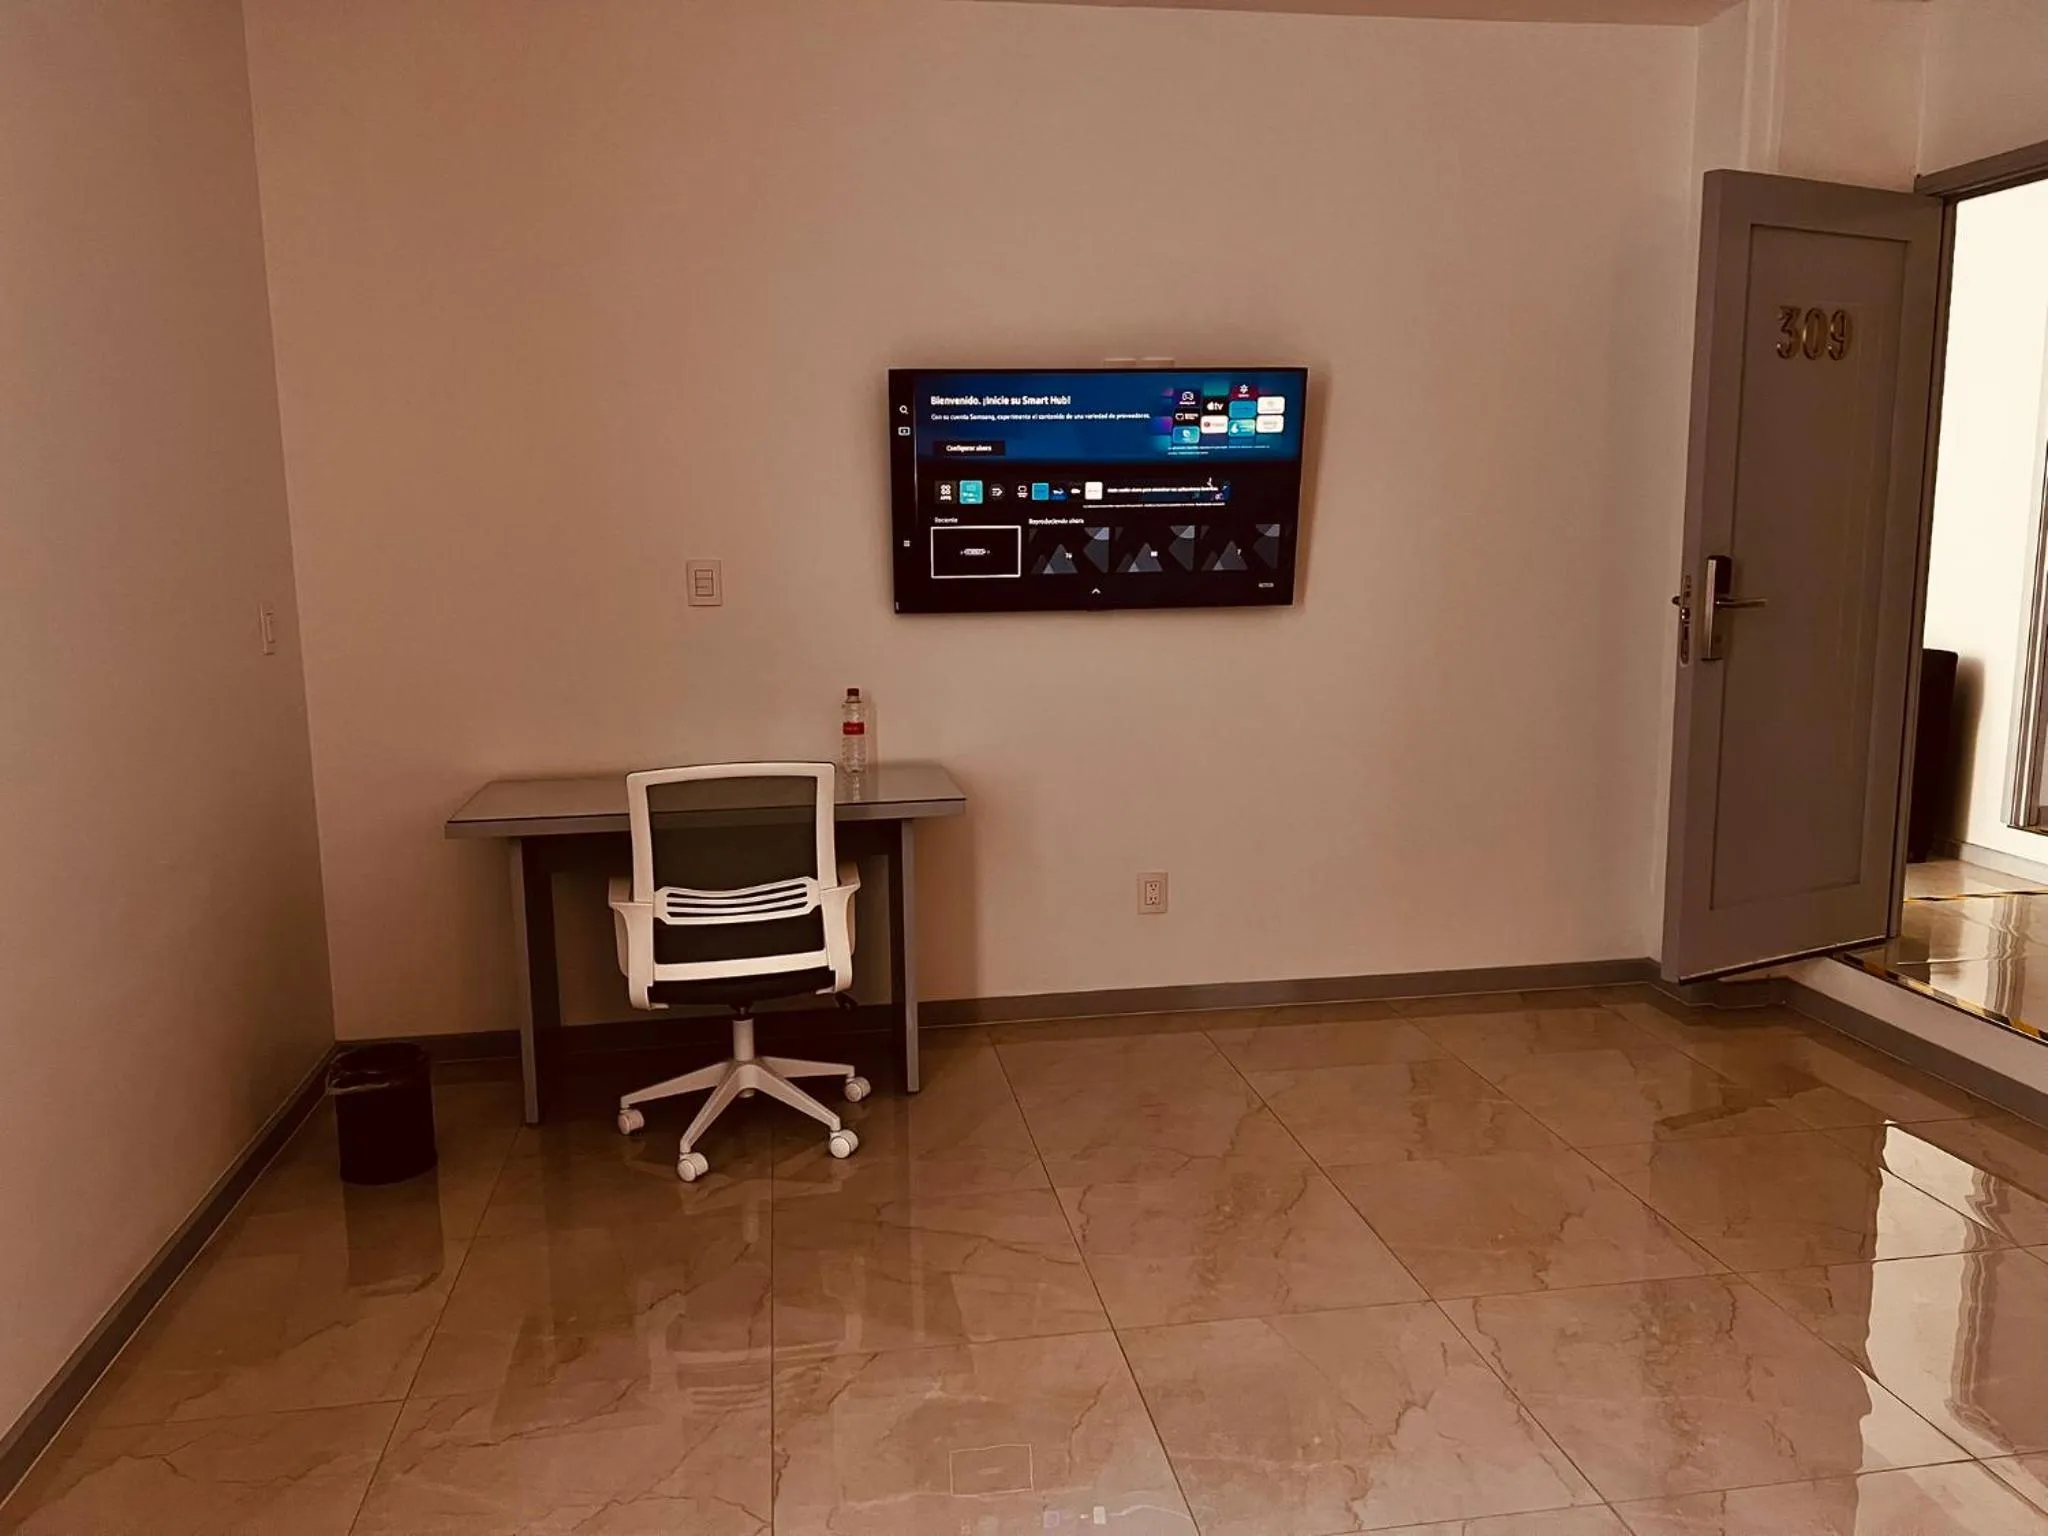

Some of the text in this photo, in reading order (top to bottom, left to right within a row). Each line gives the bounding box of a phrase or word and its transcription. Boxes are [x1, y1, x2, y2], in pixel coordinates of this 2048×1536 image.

[1775, 305, 1853, 361] 309
[1010, 396, 1021, 405] su
[1022, 395, 1049, 405] Smart
[1050, 395, 1071, 405] Hub!
